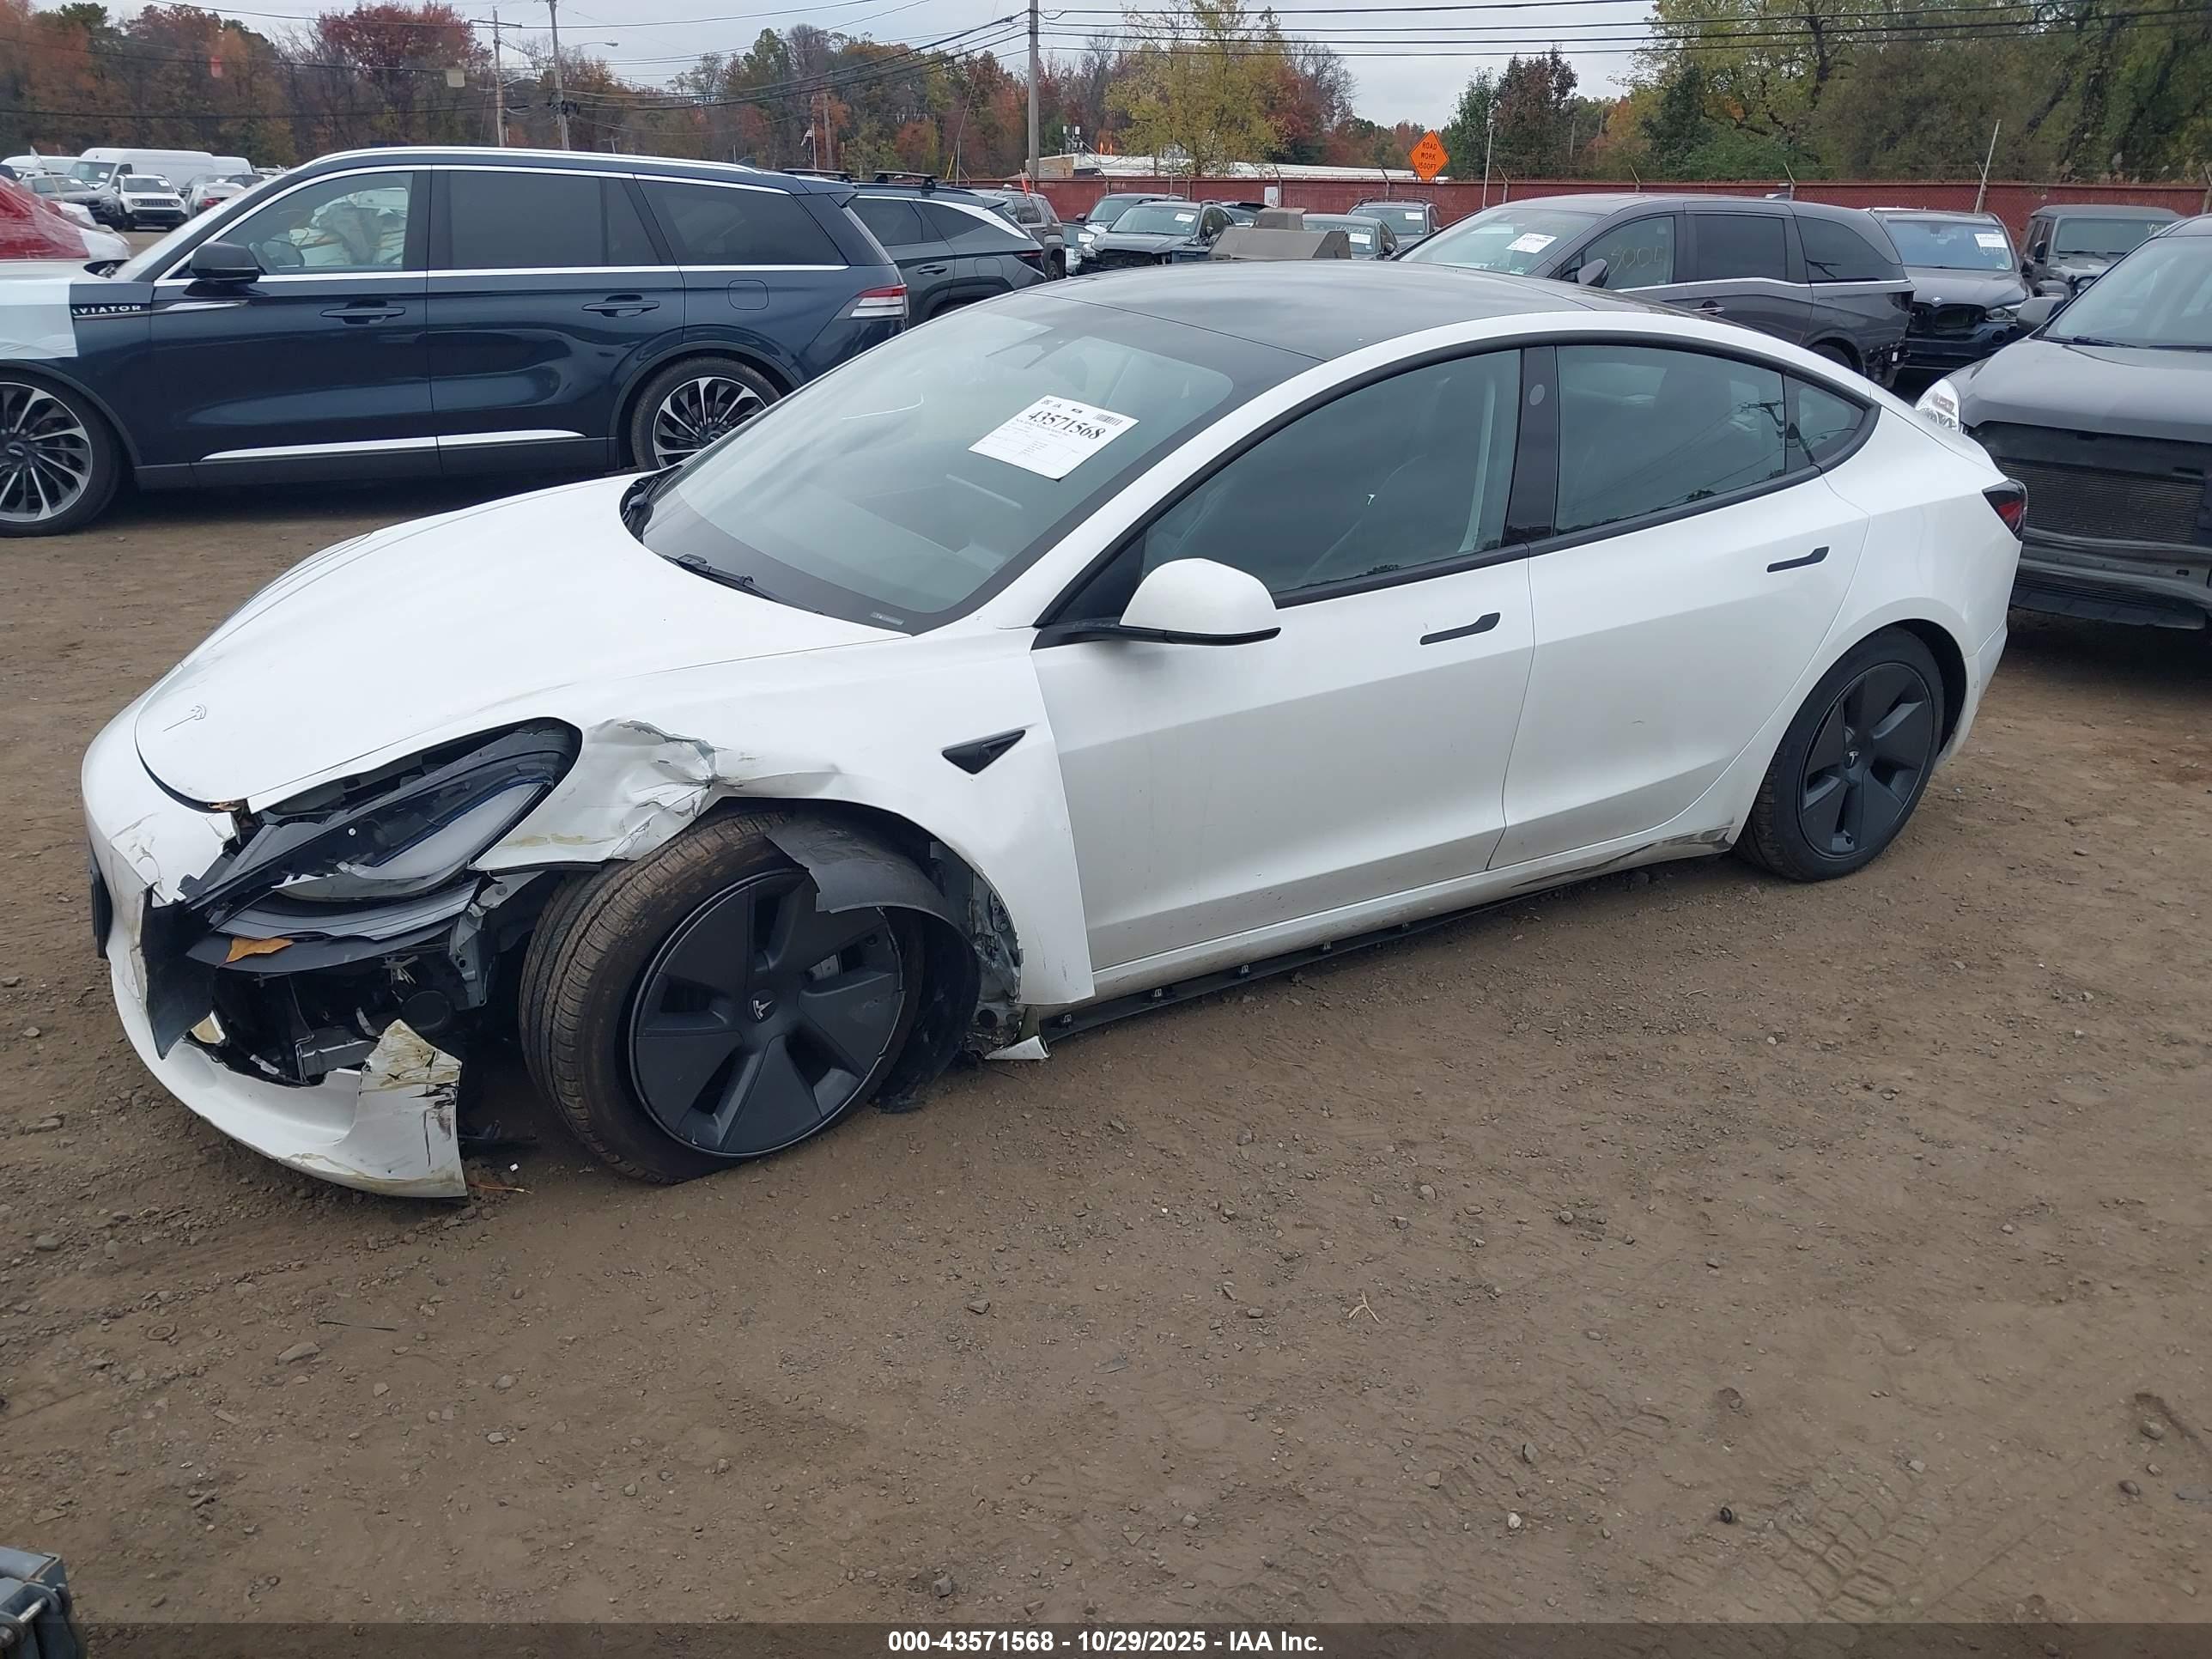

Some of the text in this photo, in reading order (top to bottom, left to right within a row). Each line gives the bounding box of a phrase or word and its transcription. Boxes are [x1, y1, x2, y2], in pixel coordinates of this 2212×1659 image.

[1422, 142, 1437, 150] ROAD
[1421, 152, 1437, 161] WORK
[1028, 410, 1106, 440] 43571568
